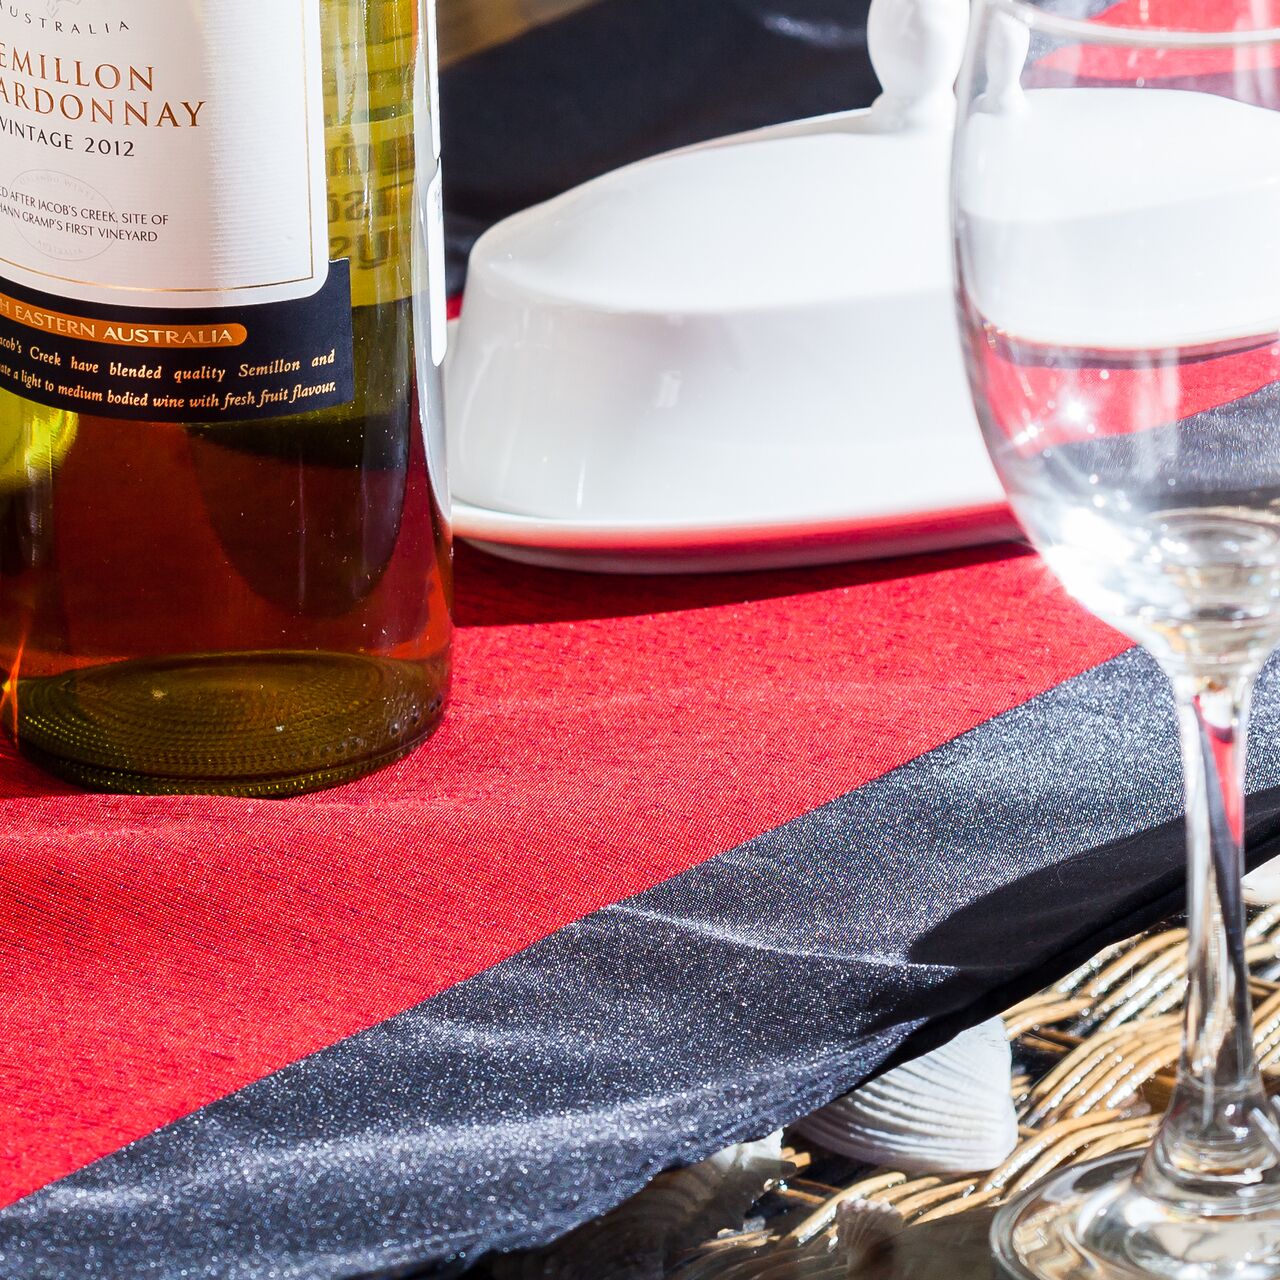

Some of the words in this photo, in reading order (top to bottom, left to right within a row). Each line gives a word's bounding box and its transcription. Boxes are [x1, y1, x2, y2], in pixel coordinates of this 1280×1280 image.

[84, 136, 136, 157] 2012
[10, 191, 36, 208] AFTER
[37, 198, 78, 218] JACOB'S
[121, 212, 148, 225] SITE
[151, 213, 169, 226] OF
[22, 211, 64, 232] GRAMP'S
[65, 222, 96, 237] FIRST
[97, 227, 159, 242] VINEYARD
[15, 306, 96, 338] EASTERN
[103, 326, 233, 344] AUSTRALIA
[29, 346, 62, 366] Creek
[70, 356, 99, 373] have
[109, 361, 162, 379] blended
[173, 365, 226, 384] quality
[238, 358, 301, 378] Semillon
[311, 348, 336, 368] and
[13, 370, 19, 380] a
[20, 369, 41, 389] light
[44, 380, 54, 392] to
[57, 384, 103, 402] medium
[107, 389, 149, 406] bodied
[153, 394, 184, 408] wine
[189, 393, 219, 408] with
[221, 390, 256, 410] fresh
[255, 388, 288, 408] fruit
